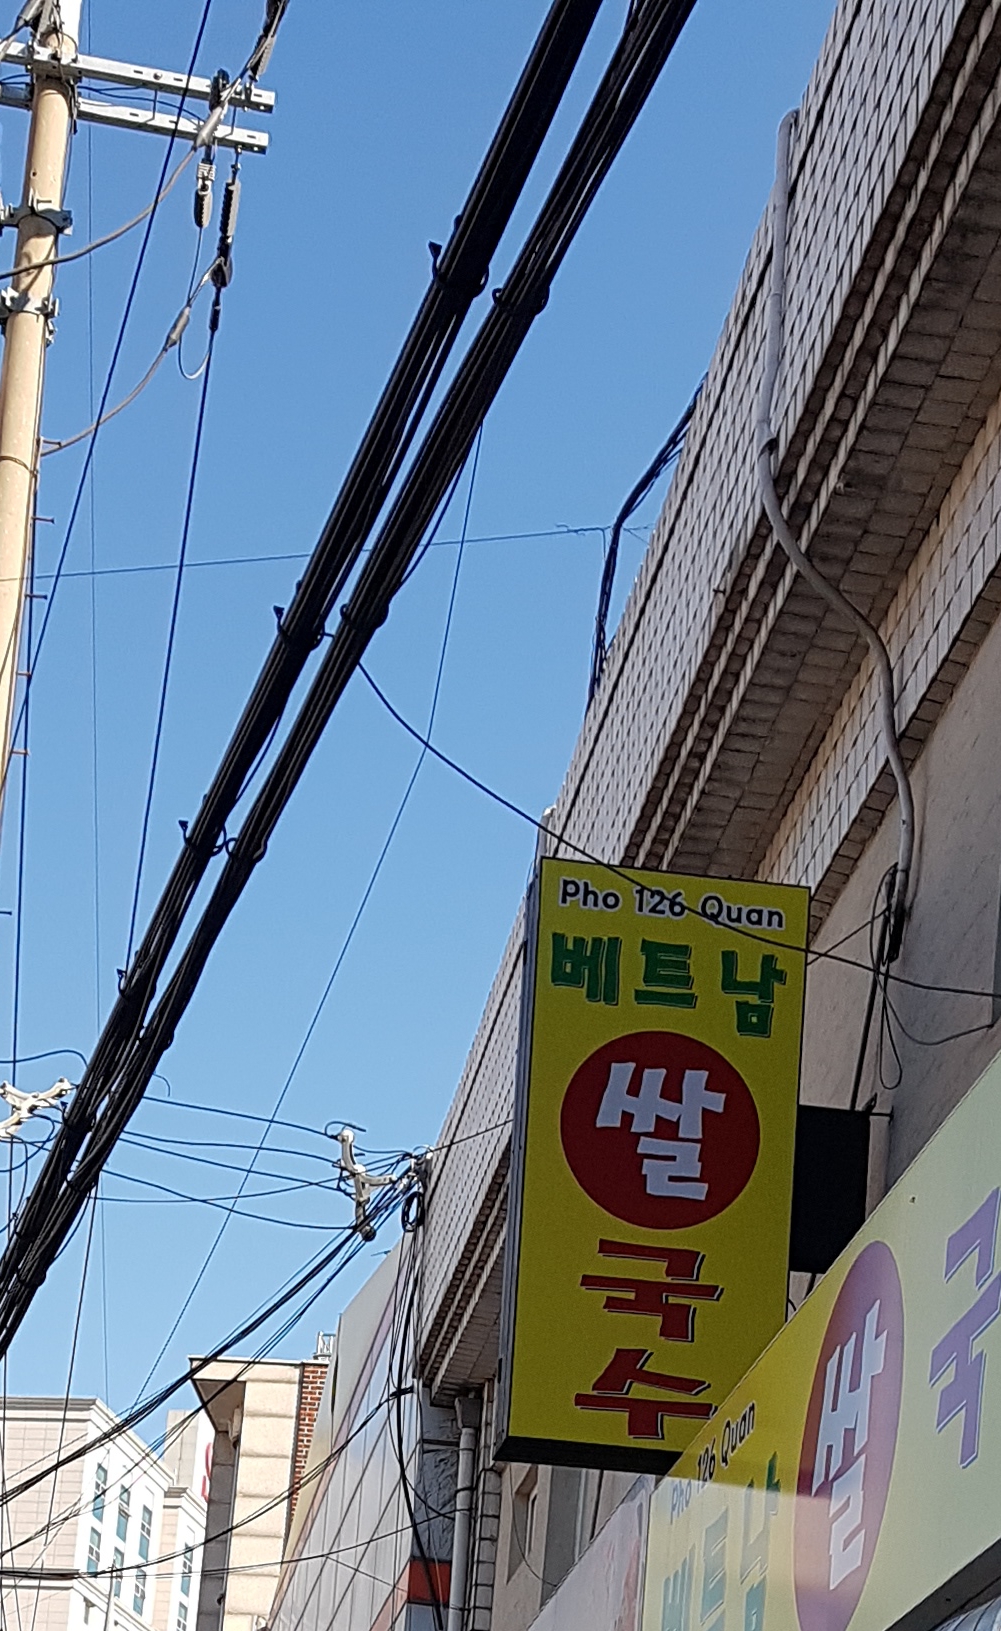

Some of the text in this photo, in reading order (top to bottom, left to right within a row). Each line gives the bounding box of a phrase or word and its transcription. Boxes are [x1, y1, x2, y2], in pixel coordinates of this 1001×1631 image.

[560, 877, 785, 930] Pho 126 Quan
[551, 932, 787, 1038] 베트남
[670, 1400, 756, 1526] Pho 126 Quan
